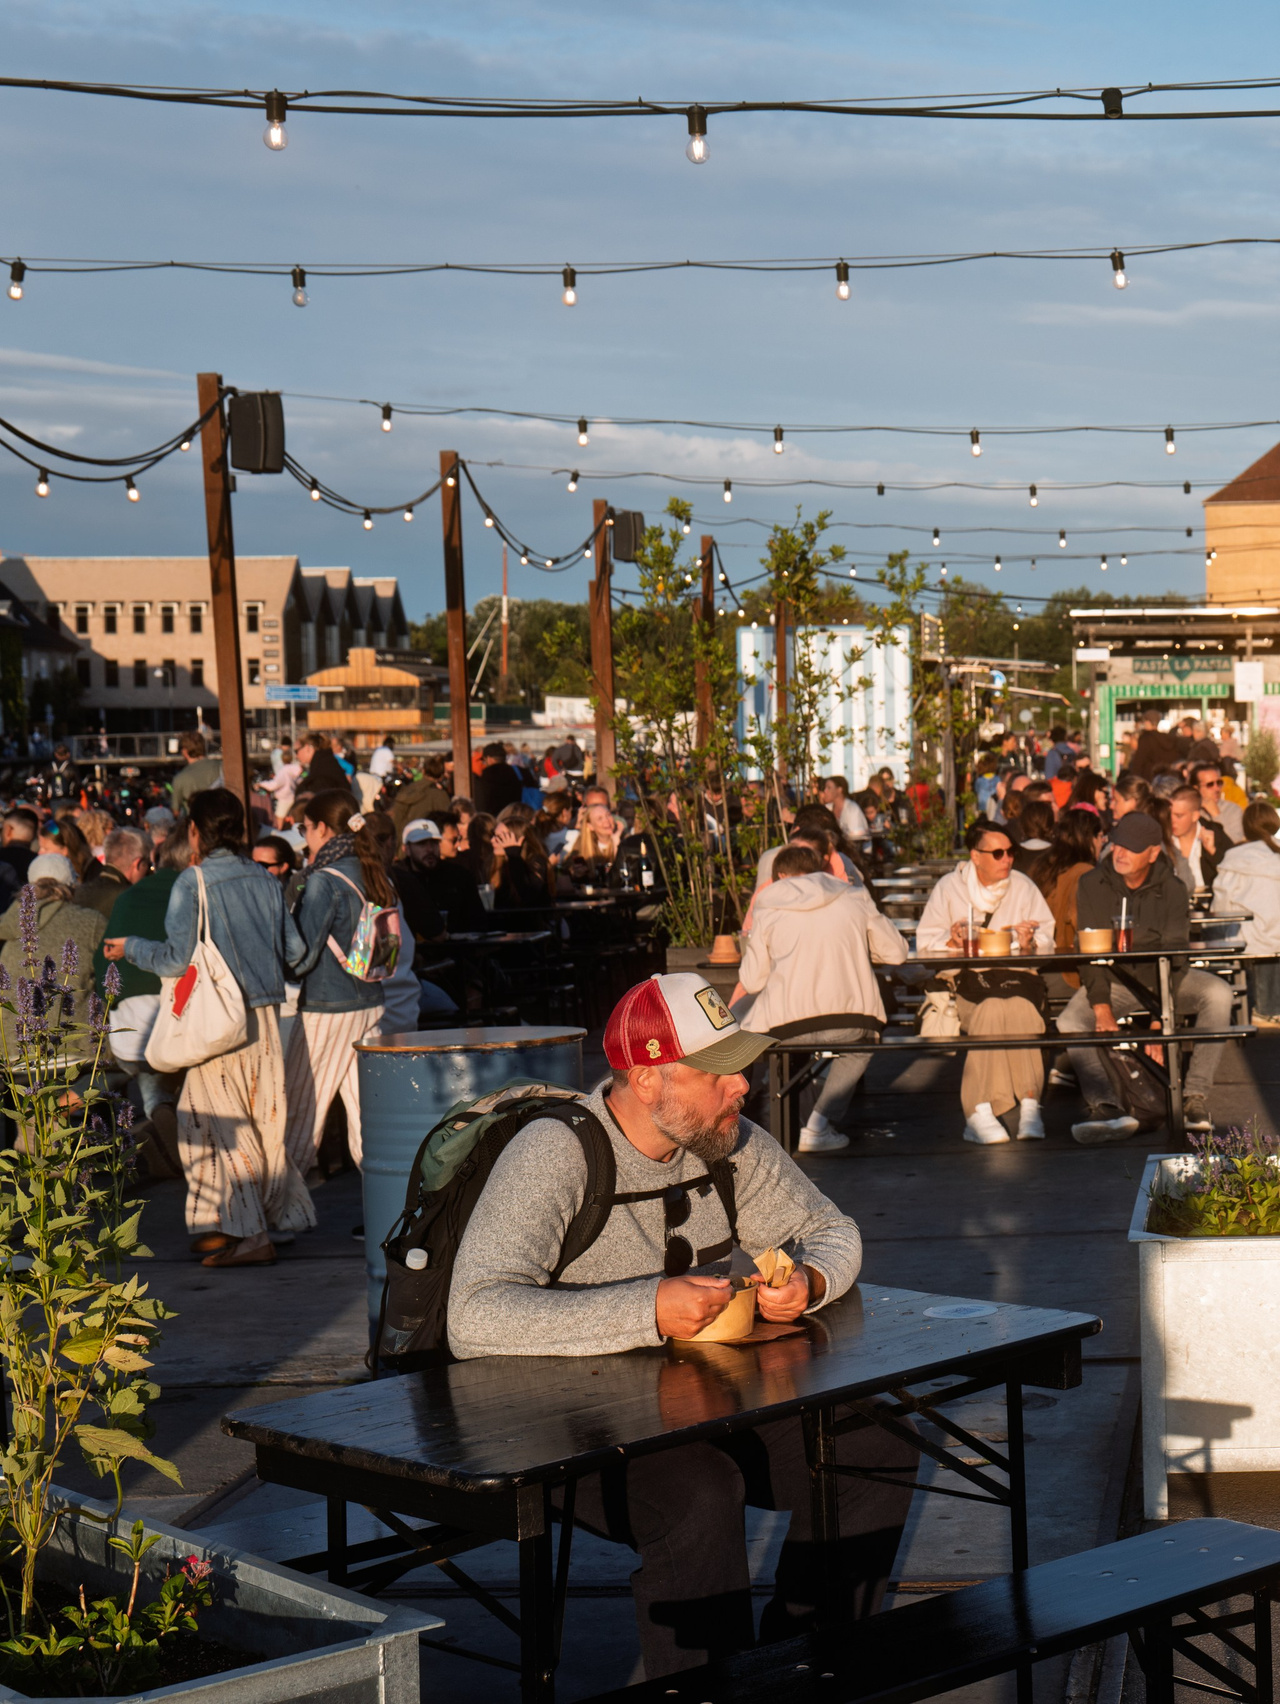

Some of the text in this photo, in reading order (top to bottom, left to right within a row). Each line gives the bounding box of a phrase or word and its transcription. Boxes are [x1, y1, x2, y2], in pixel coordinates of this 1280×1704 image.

[1134, 659, 1230, 671] PASTA LA PASTA
